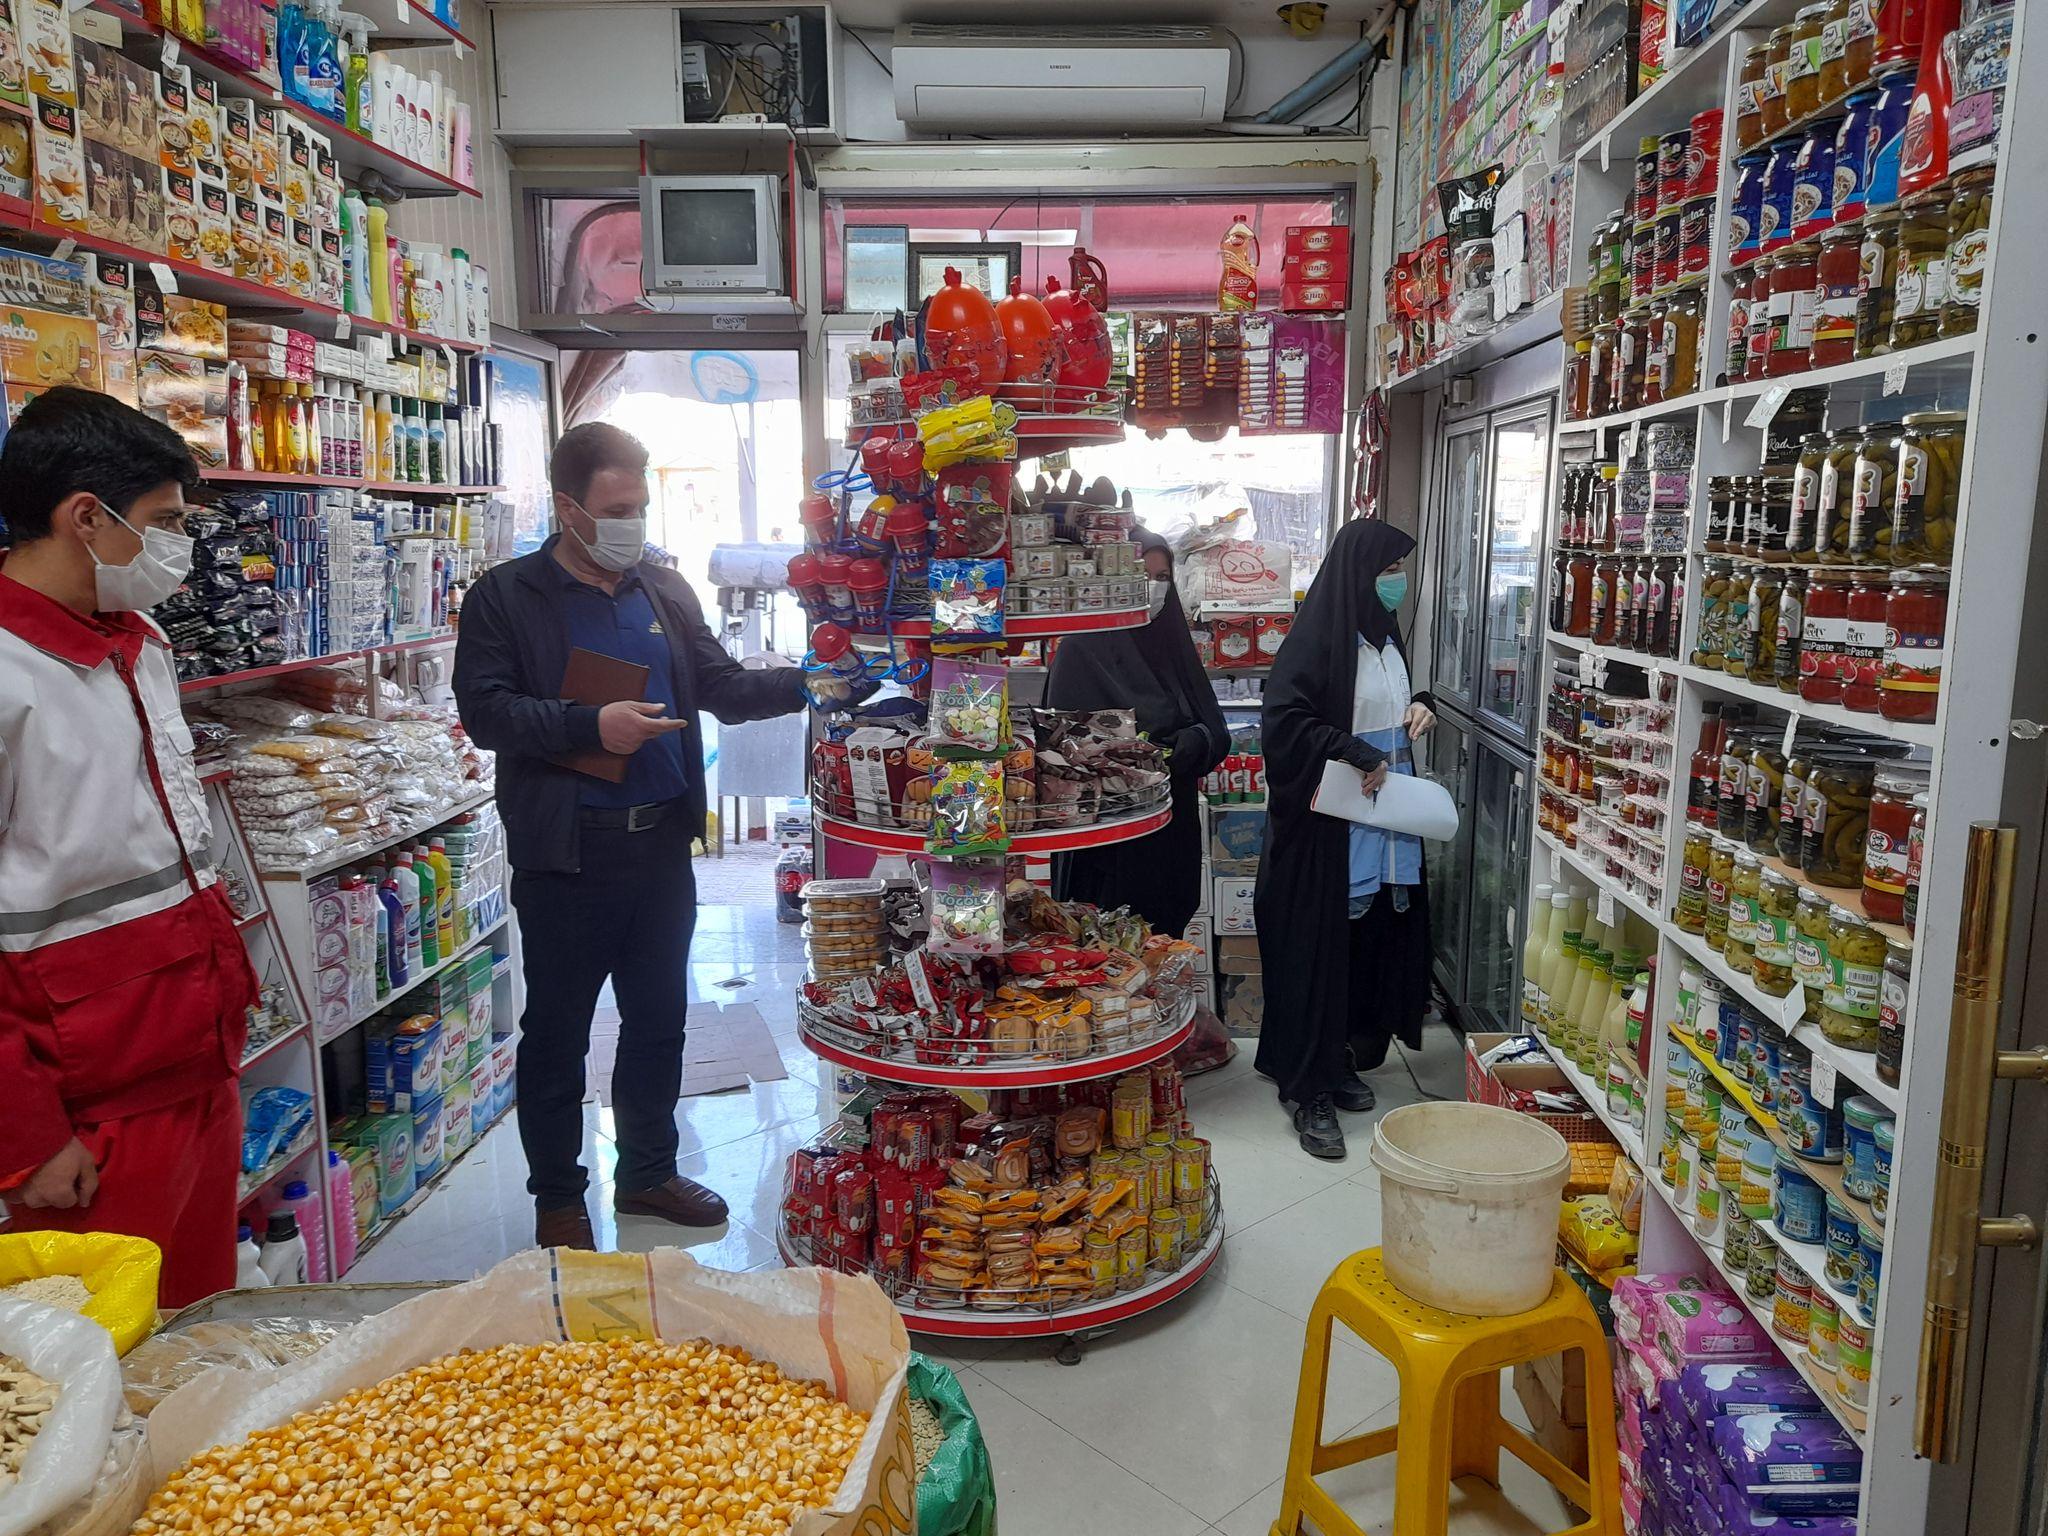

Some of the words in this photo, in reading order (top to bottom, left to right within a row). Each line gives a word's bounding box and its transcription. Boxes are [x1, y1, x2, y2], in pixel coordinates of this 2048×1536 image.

[1811, 642, 1835, 653] Paste
[1850, 648, 1874, 658] Paste
[1689, 1067, 1705, 1083] Sta
[1721, 1113, 1742, 1132] tar
